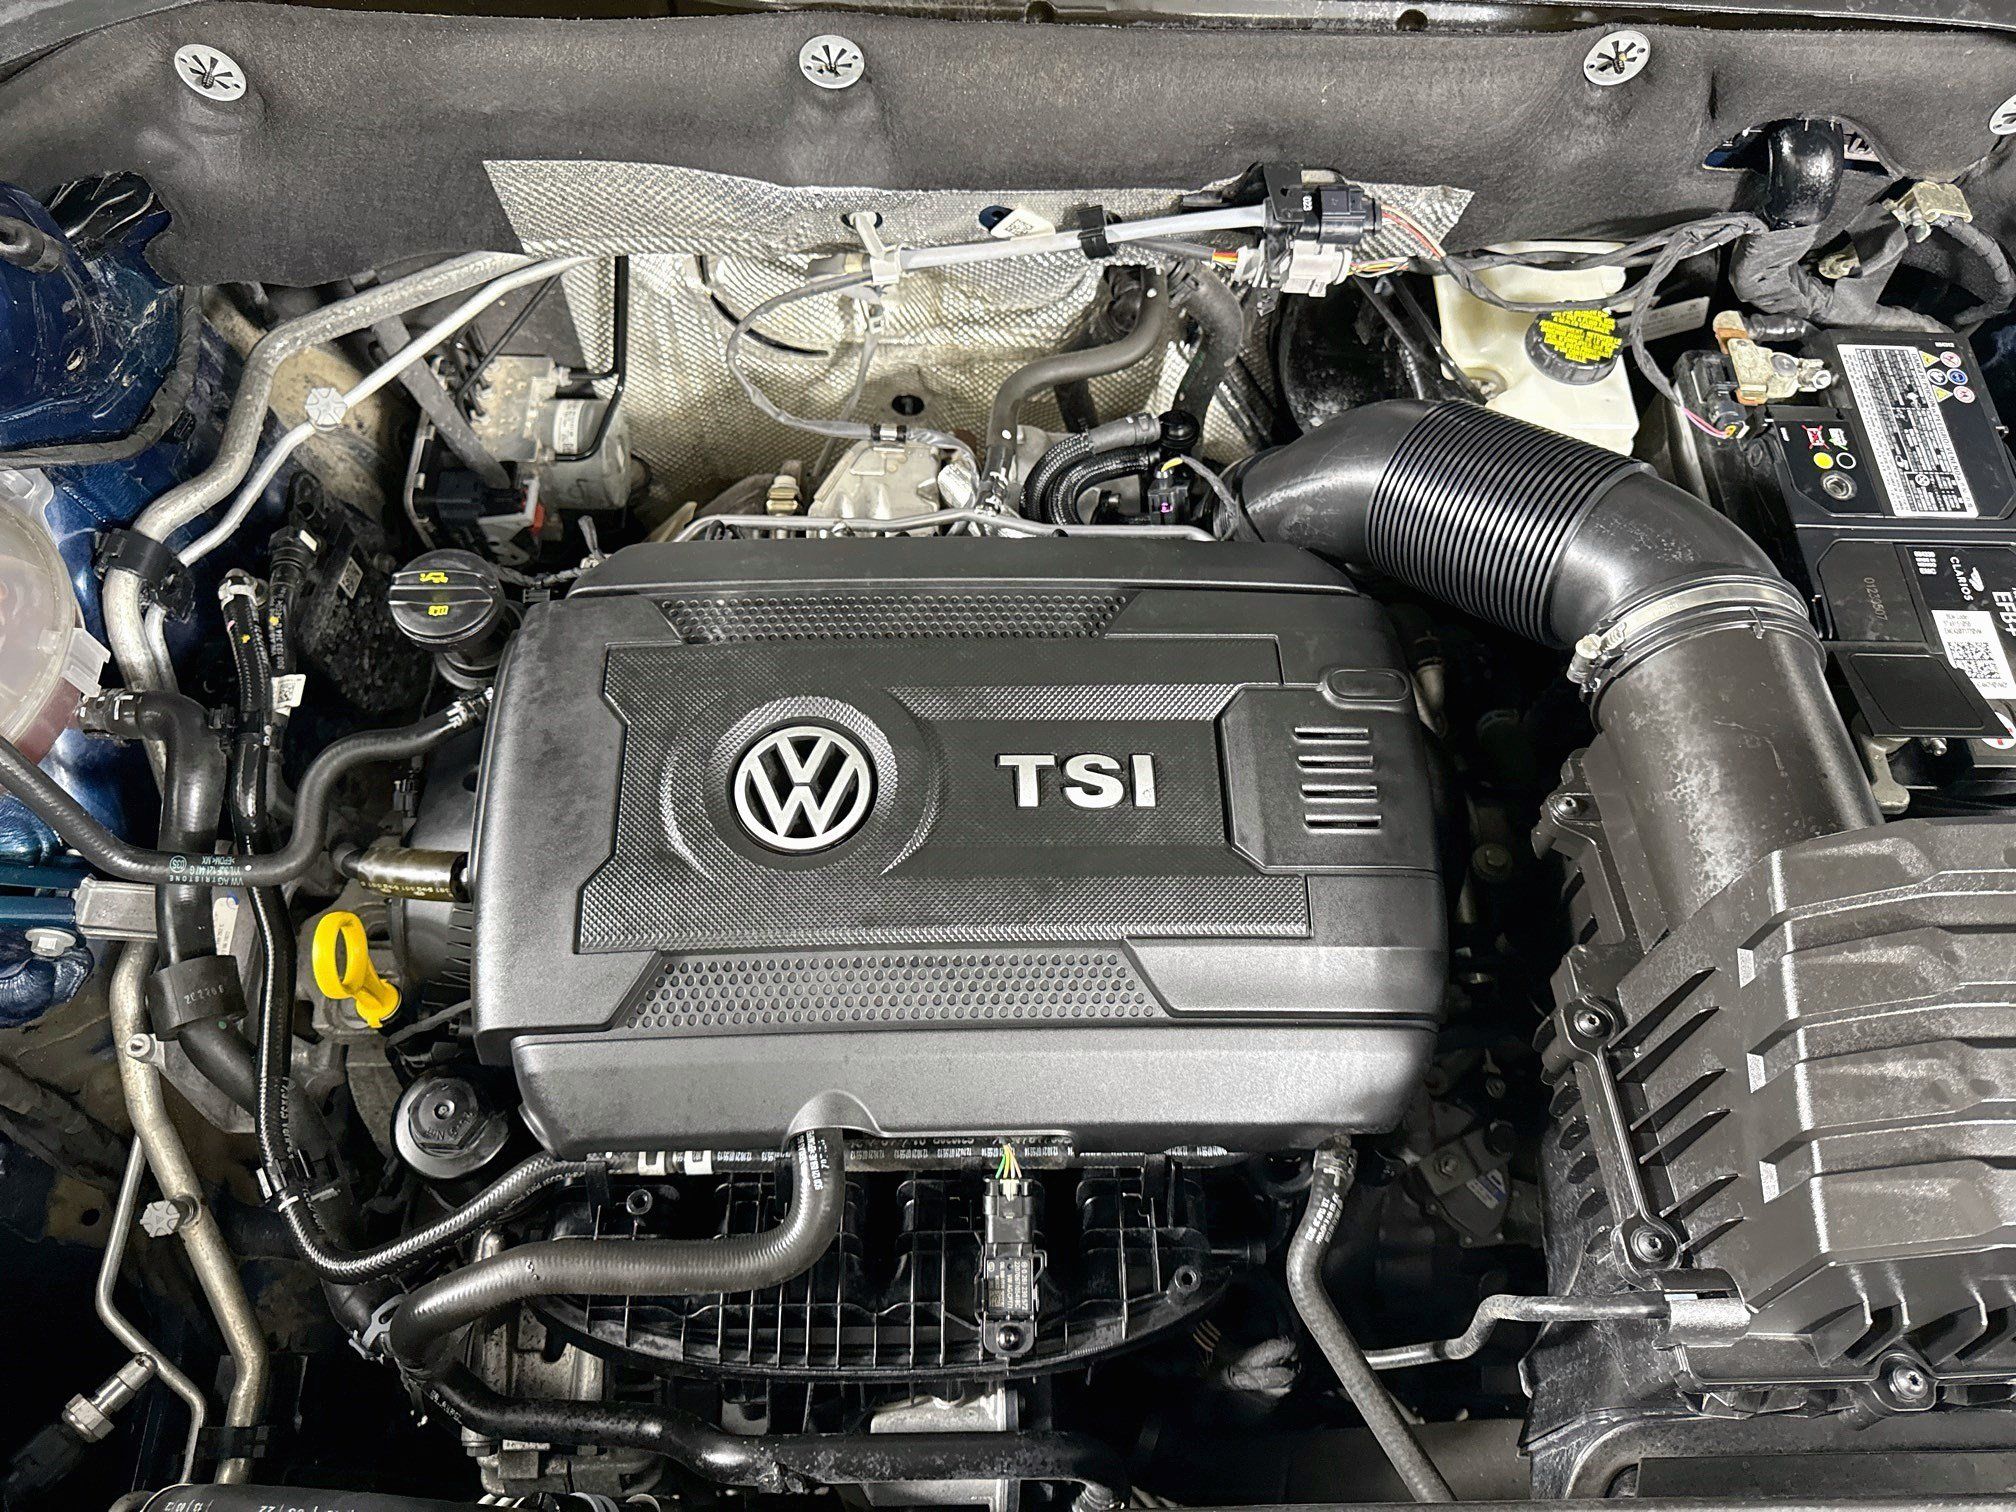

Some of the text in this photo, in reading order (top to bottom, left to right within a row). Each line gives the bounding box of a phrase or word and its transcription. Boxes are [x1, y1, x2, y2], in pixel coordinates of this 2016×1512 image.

[1949, 556, 1974, 601] CLARIOS
[1992, 592, 2016, 636] EFB+
[997, 752, 1157, 810] TSI
[218, 876, 230, 886] AG
[232, 876, 244, 886] VW
